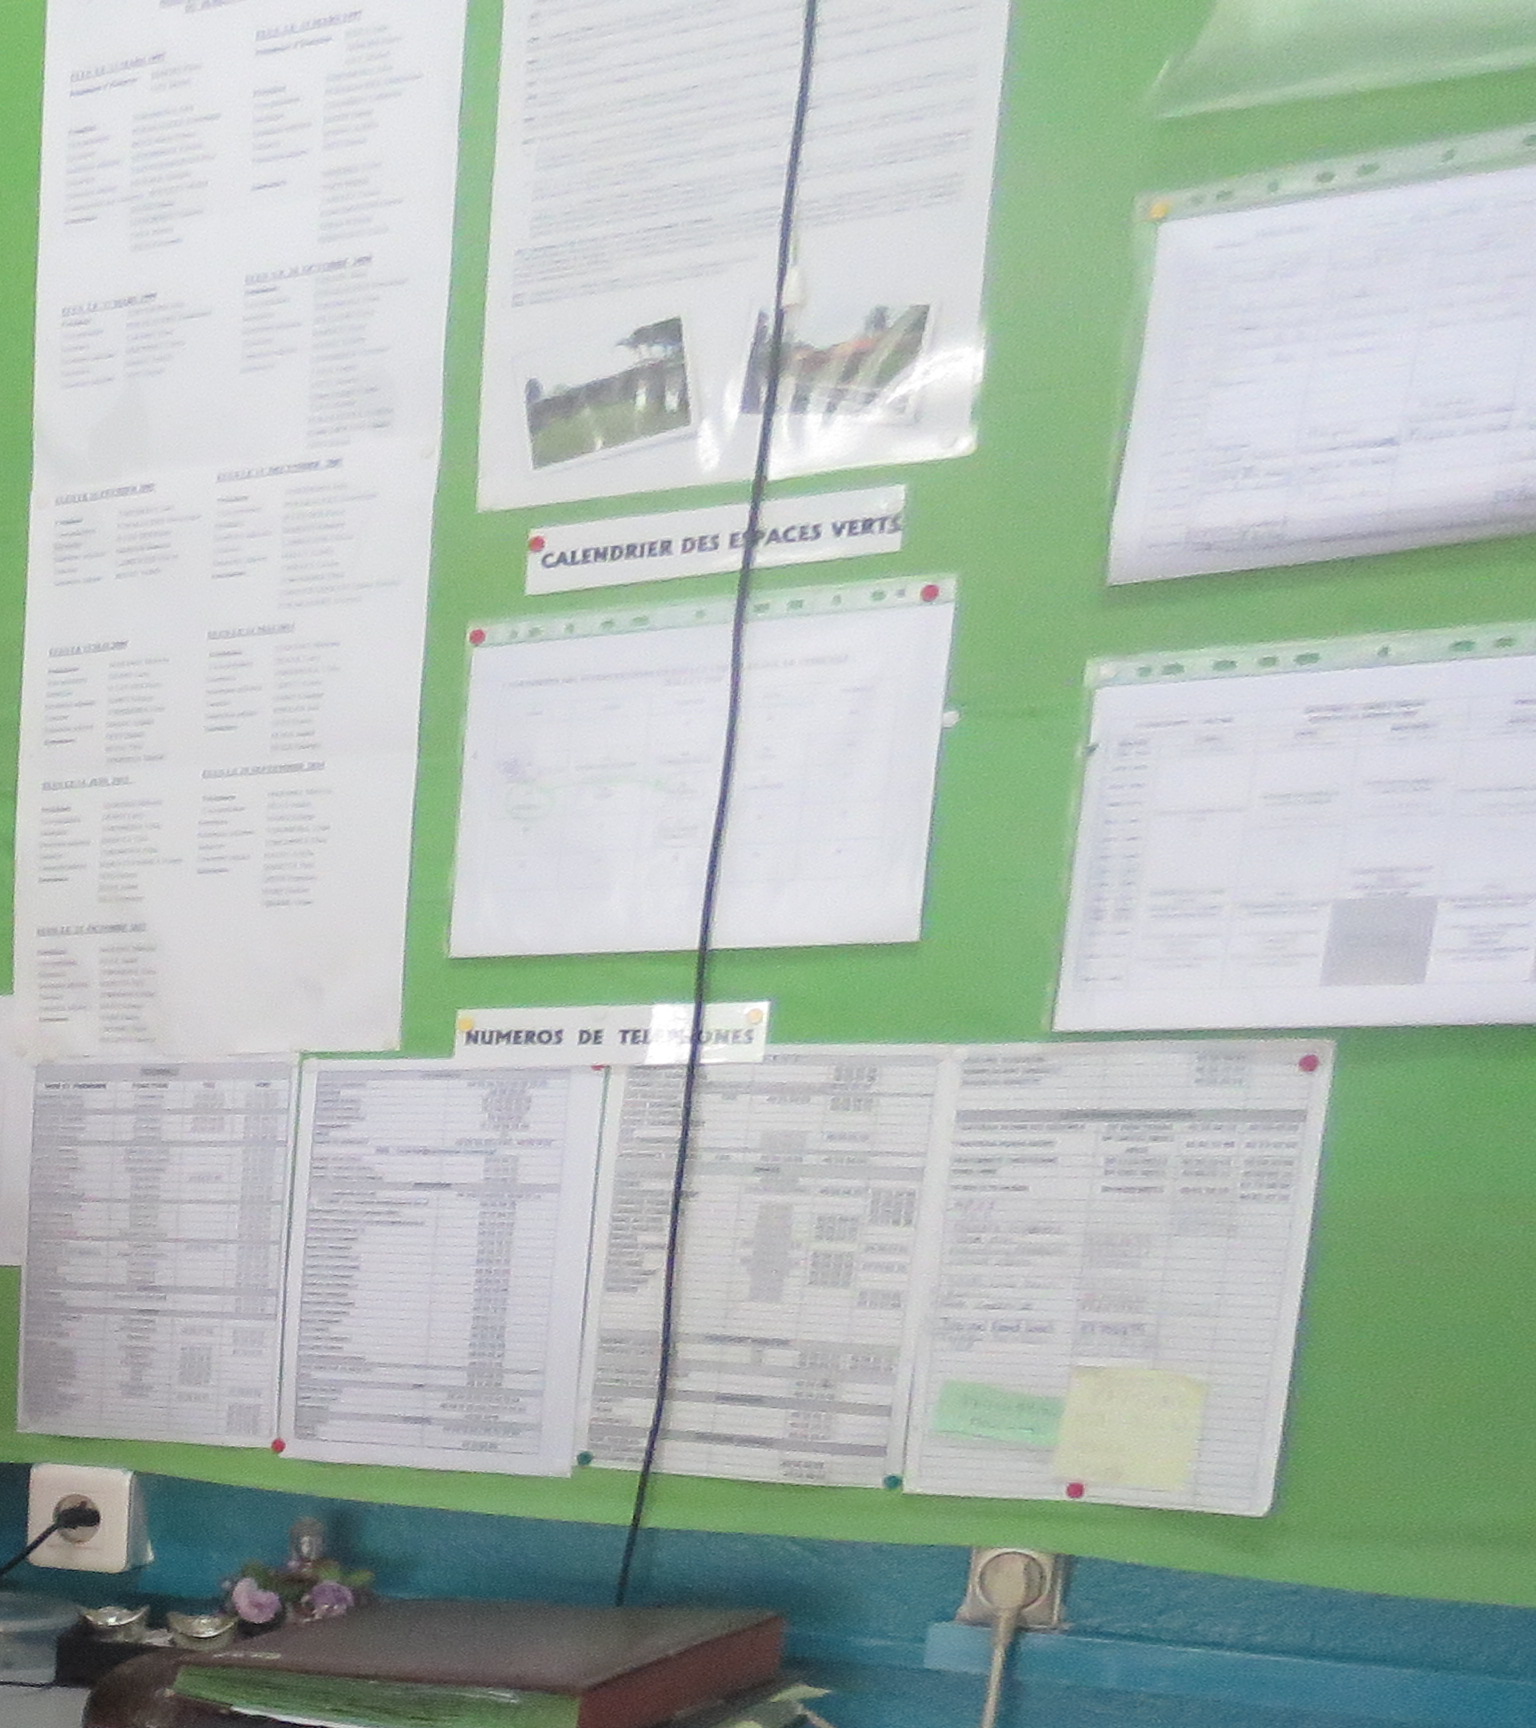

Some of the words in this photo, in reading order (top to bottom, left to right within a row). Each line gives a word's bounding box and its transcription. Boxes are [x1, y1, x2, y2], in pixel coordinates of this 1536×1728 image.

[540, 539, 675, 569] CALENDRIER
[681, 532, 720, 554] DES
[728, 521, 823, 551] EPACES
[830, 512, 904, 539] VERTS
[464, 1028, 565, 1046] NUMEROS
[577, 1028, 604, 1046] DE
